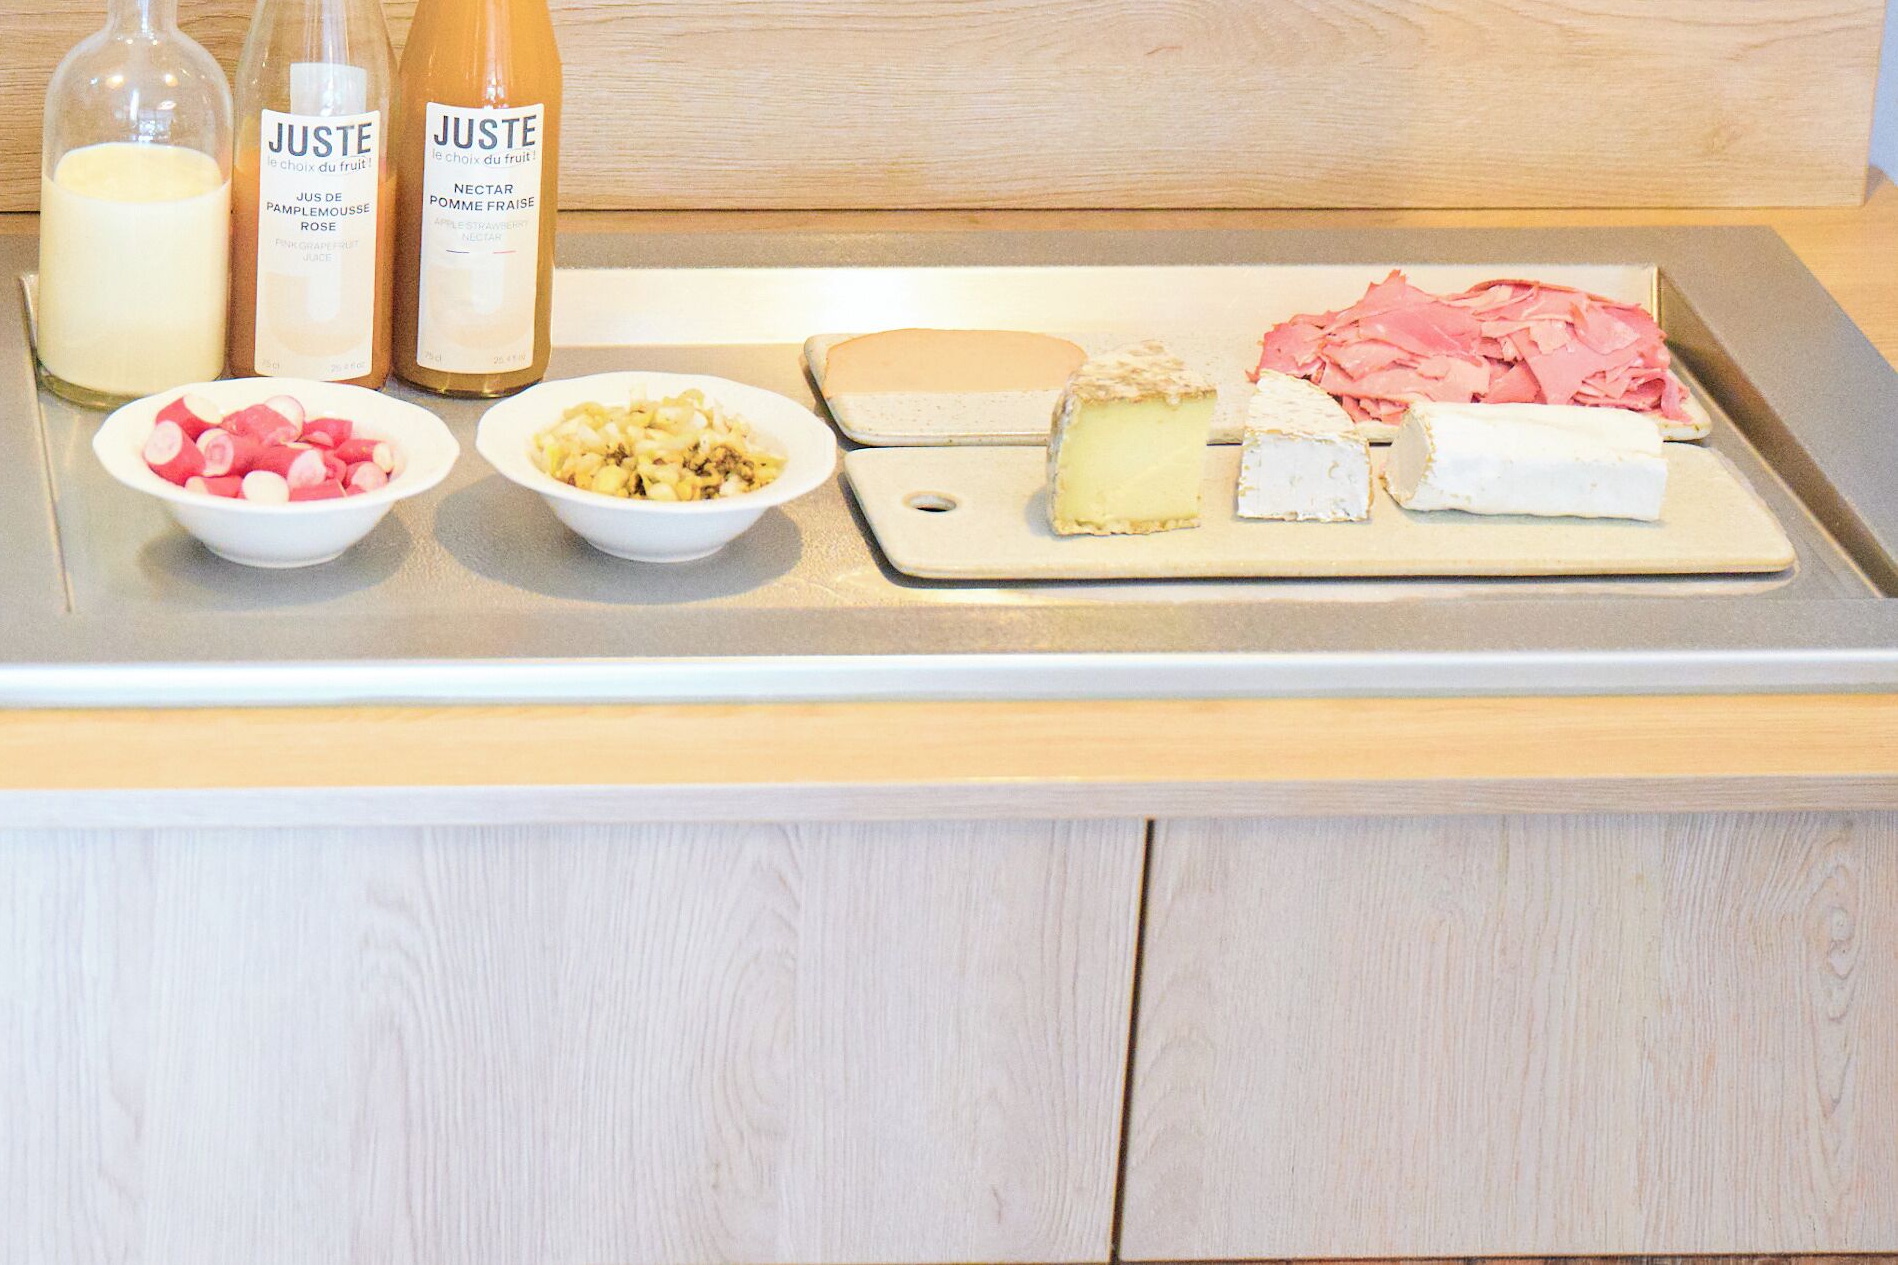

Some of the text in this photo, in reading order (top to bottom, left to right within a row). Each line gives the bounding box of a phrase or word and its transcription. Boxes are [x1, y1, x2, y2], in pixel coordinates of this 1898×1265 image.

[433, 114, 537, 150] JUSTE
[268, 122, 373, 158] JUSTE
[432, 148, 442, 160] le
[445, 151, 480, 165] choix
[484, 154, 501, 165] du
[267, 156, 277, 167] le
[280, 159, 315, 172] choix
[318, 162, 337, 173] du
[454, 183, 514, 195] NECTAR
[296, 192, 343, 202] JUS DE
[430, 195, 535, 211] POMME FRAISE
[266, 201, 370, 217] PAMPLEMOUSSE
[300, 221, 337, 232] ROSE
[434, 218, 529, 230] APPLE STRAWBERRY
[461, 233, 502, 242] NECTAR
[275, 238, 359, 252] PINK GRAPEFRUIT
[303, 253, 333, 263] JUICE
